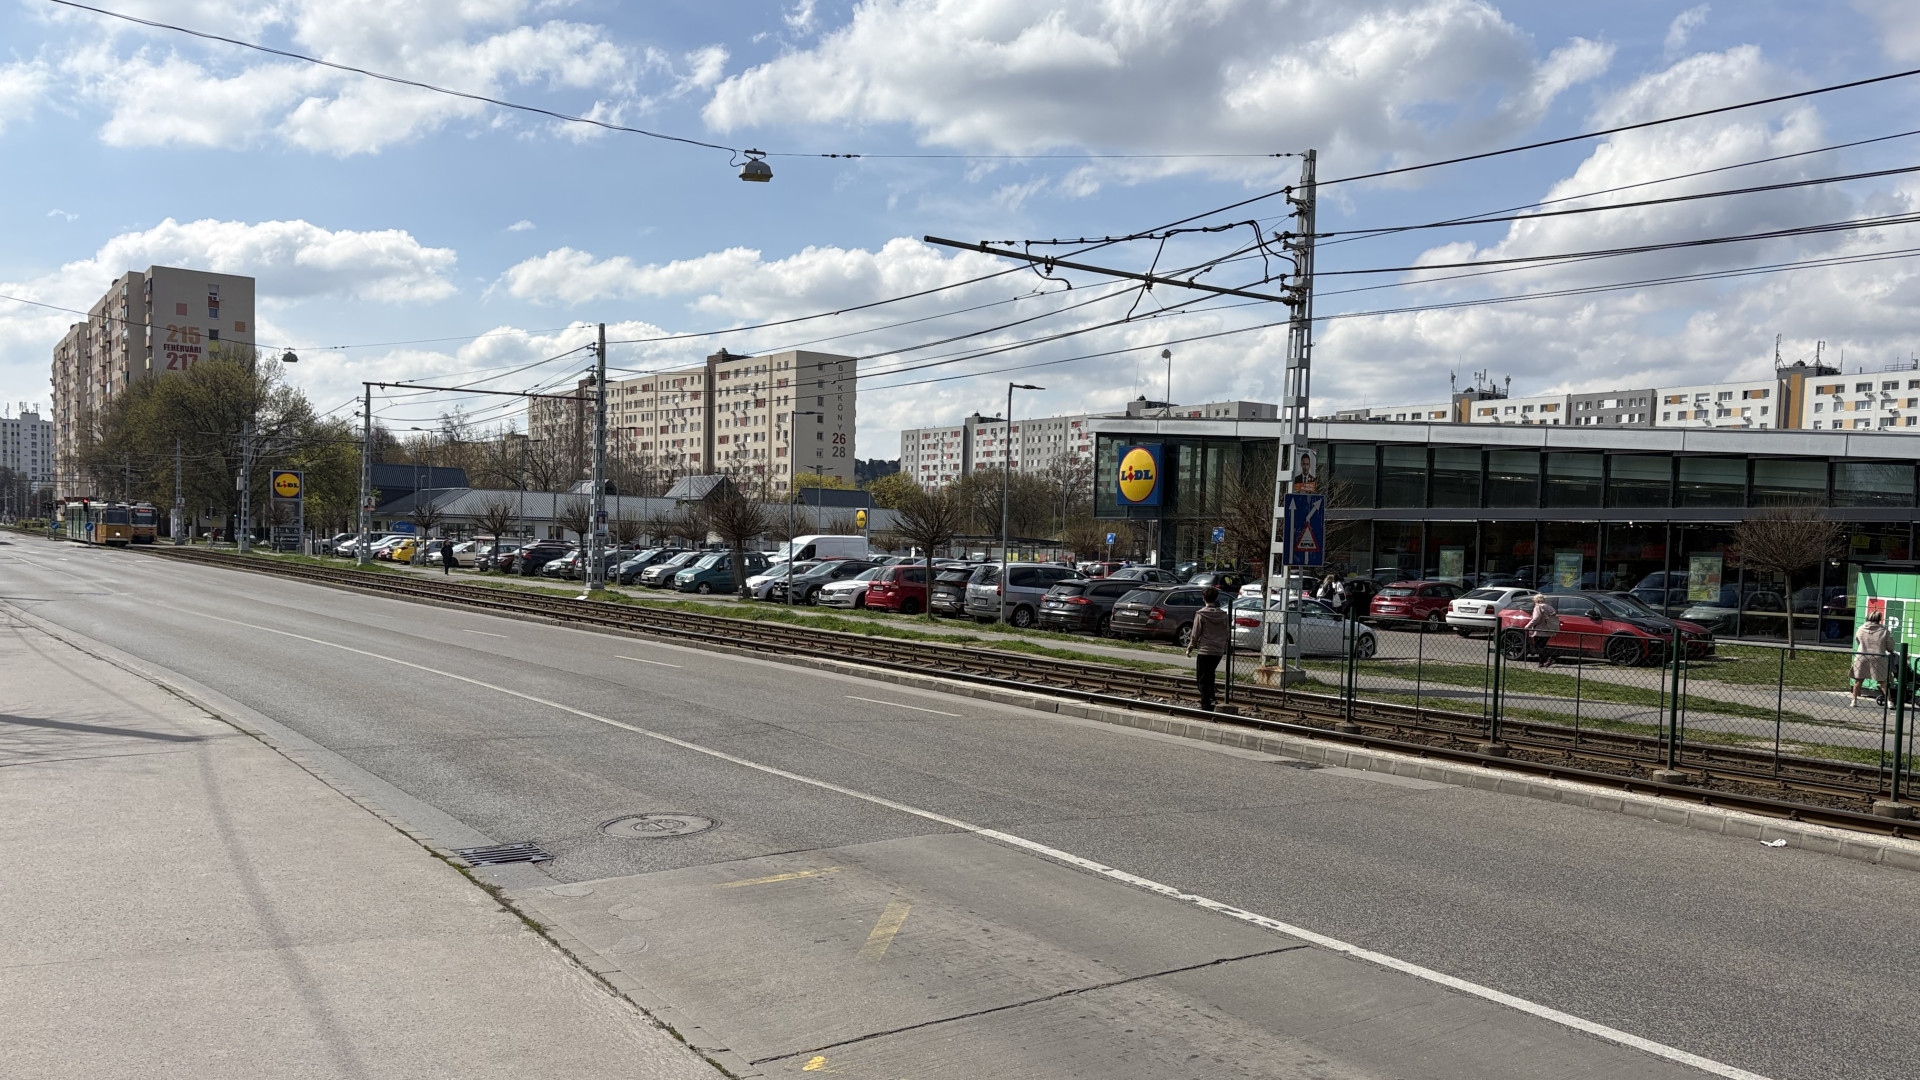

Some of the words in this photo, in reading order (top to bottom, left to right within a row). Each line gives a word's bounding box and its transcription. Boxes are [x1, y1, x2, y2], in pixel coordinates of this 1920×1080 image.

[166, 324, 201, 344] 215
[163, 343, 202, 354] FEHÉRVÁRI
[166, 352, 198, 371] 217
[832, 432, 846, 445] 26
[832, 446, 846, 458] 28
